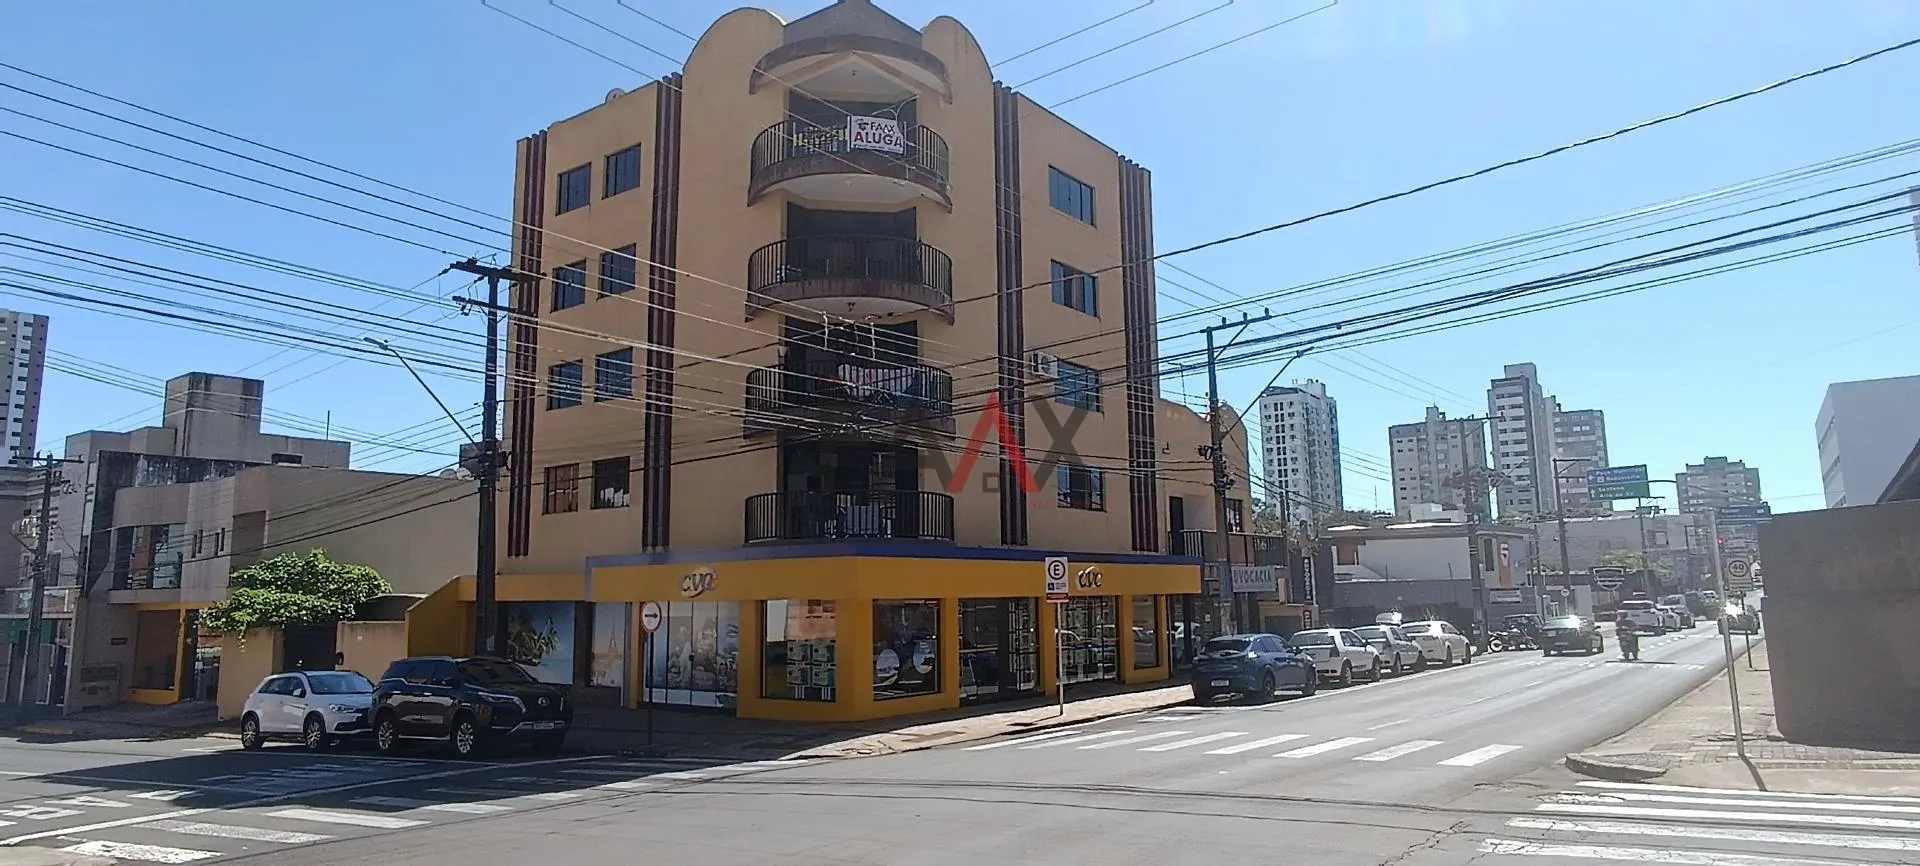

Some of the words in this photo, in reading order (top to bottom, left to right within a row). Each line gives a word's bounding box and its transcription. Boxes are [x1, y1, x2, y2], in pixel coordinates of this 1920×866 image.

[854, 131, 903, 148] ALUGA
[1053, 564, 1061, 576] E
[1233, 569, 1272, 584] DVOCACIA
